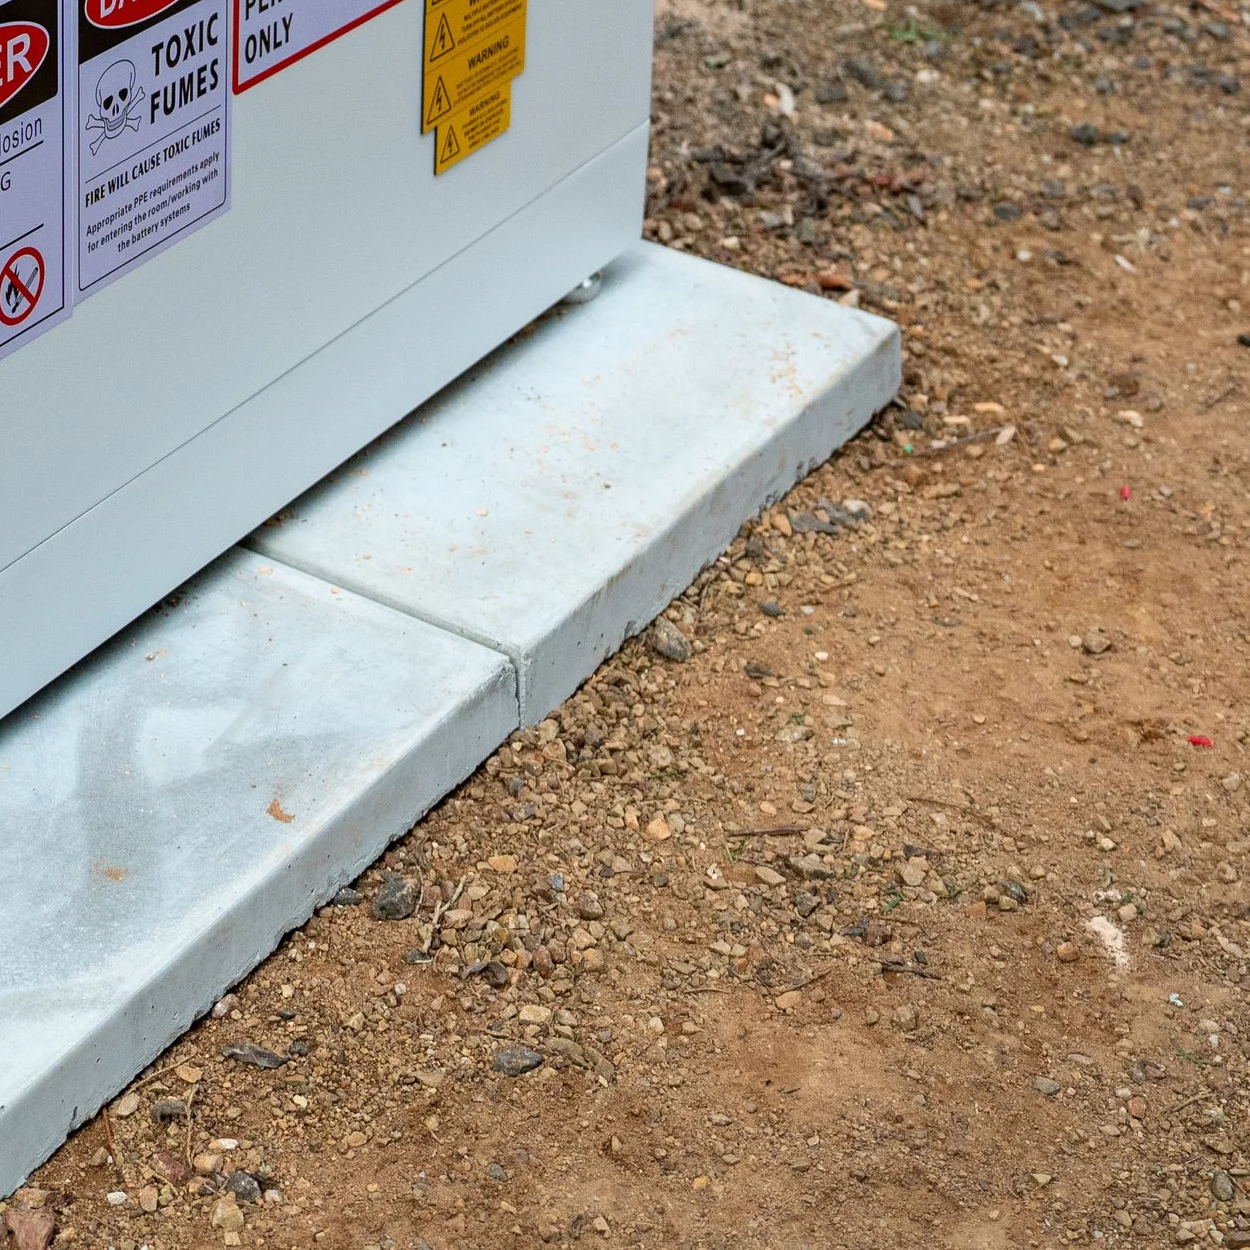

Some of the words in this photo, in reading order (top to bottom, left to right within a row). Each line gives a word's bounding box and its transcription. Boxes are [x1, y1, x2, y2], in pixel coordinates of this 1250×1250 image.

[152, 12, 218, 76] TOXIC
[245, 12, 294, 64] ONLY
[468, 35, 509, 71] WARNING
[150, 58, 219, 125] FUMES
[85, 184, 105, 208] FIRE
[107, 171, 129, 195] WILL
[132, 154, 161, 181] CAUSE
[163, 136, 190, 163] TOXIC
[192, 118, 221, 146] FUMES
[86, 202, 133, 237] Appropriate
[134, 191, 148, 209] PPE
[149, 164, 199, 199] requirements
[199, 150, 220, 170] apply
[87, 239, 99, 253] for
[100, 221, 133, 246] entering
[134, 211, 147, 226] the
[147, 179, 201, 218] room/working
[202, 168, 219, 185] with
[117, 238, 130, 252] the
[132, 221, 159, 245] battery
[160, 203, 191, 228] systems
